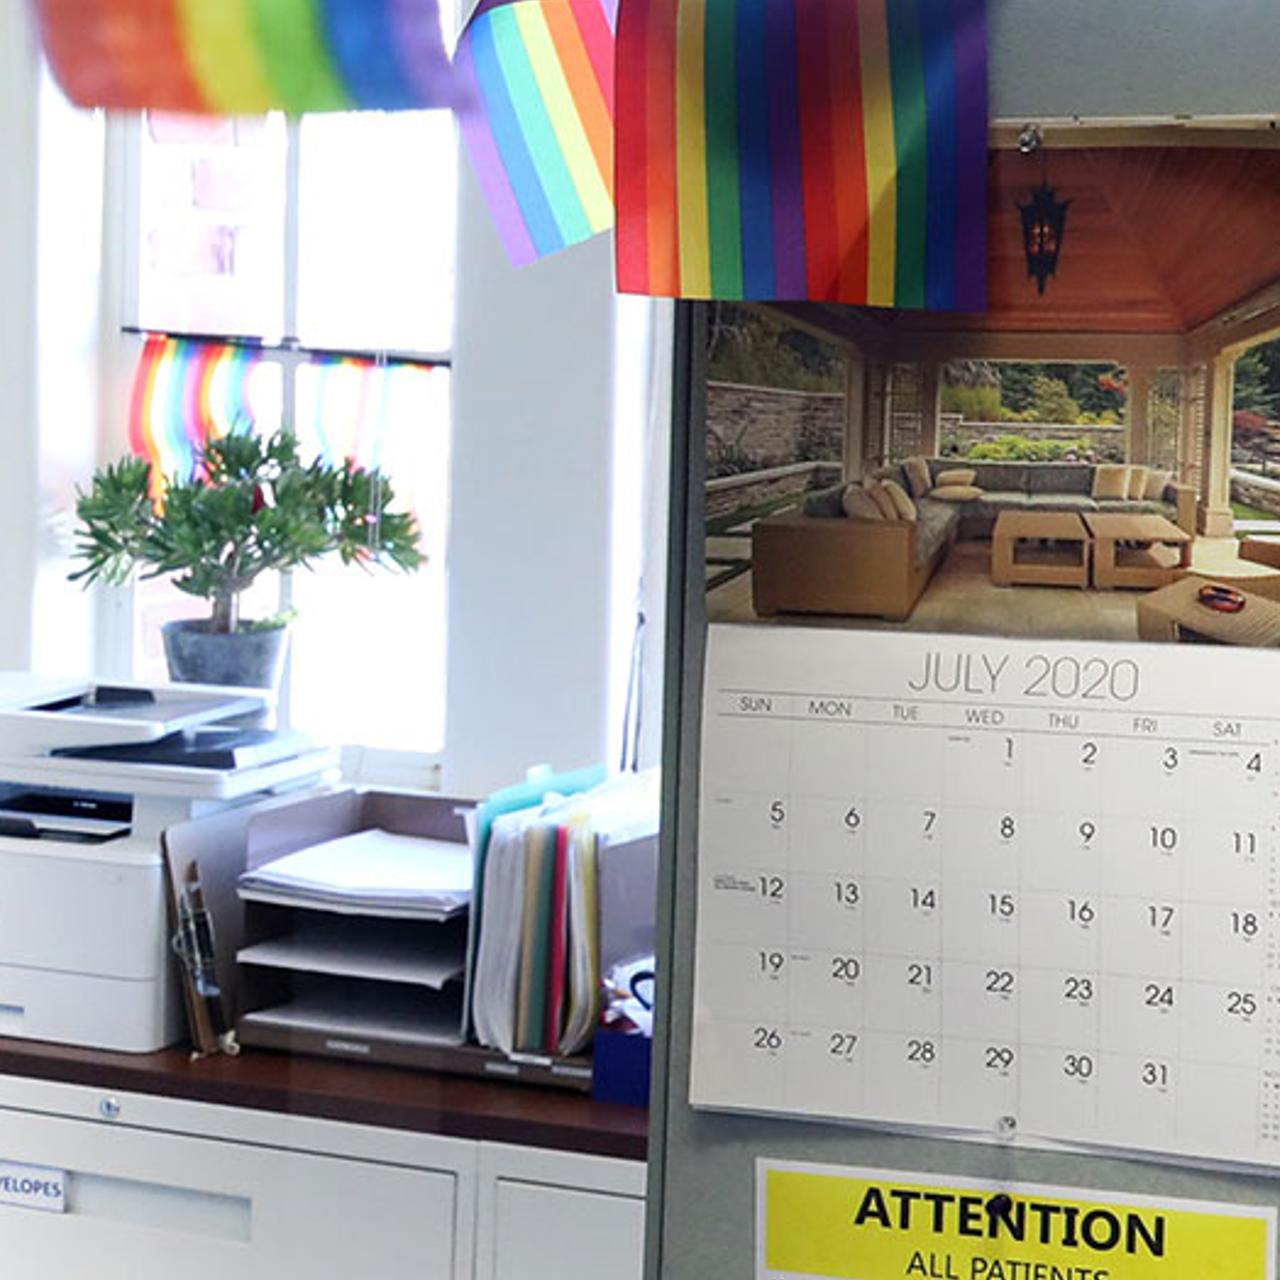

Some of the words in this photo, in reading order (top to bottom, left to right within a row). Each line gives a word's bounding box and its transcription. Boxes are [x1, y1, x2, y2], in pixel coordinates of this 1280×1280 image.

[908, 652, 1009, 694] JULY
[1023, 654, 1139, 702] 2020
[739, 696, 772, 713] SUN
[808, 700, 852, 717] MON
[893, 704, 919, 721] TUE
[965, 708, 1005, 725] WED
[1048, 712, 1079, 729] THU
[1133, 717, 1158, 733] FRI
[1213, 721, 1241, 737] SAT
[1005, 737, 1014, 759] 1
[1081, 741, 1098, 765] 2
[1162, 746, 1179, 770] 3
[1245, 752, 1262, 774] 4
[770, 800, 785, 824] 5
[844, 807, 861, 829] 6
[923, 810, 937, 832] 7
[1000, 815, 1016, 839] 8
[1078, 821, 1096, 844] 9
[1150, 826, 1178, 851] 10
[1233, 831, 1256, 855] 11
[759, 876, 785, 900] 12
[834, 881, 860, 905] 13
[911, 887, 936, 910] 14
[988, 893, 1015, 917] 15
[1068, 899, 1095, 925] 16
[1148, 905, 1175, 929] 17
[1231, 911, 1259, 937] 18
[759, 951, 785, 973] 19
[831, 956, 861, 981] 20
[907, 963, 932, 987] 21
[985, 969, 1015, 995] 22
[1064, 976, 1094, 1001] 23
[1144, 983, 1174, 1007] 24
[1226, 991, 1257, 1017] 25
[753, 1026, 783, 1050] 26
[830, 1032, 858, 1056] 27
[907, 1039, 936, 1064] 28
[985, 1046, 1015, 1069] 29
[1063, 1054, 1093, 1078] 30
[1141, 1062, 1169, 1086] 31
[853, 1186, 1167, 1258] ATTENTION
